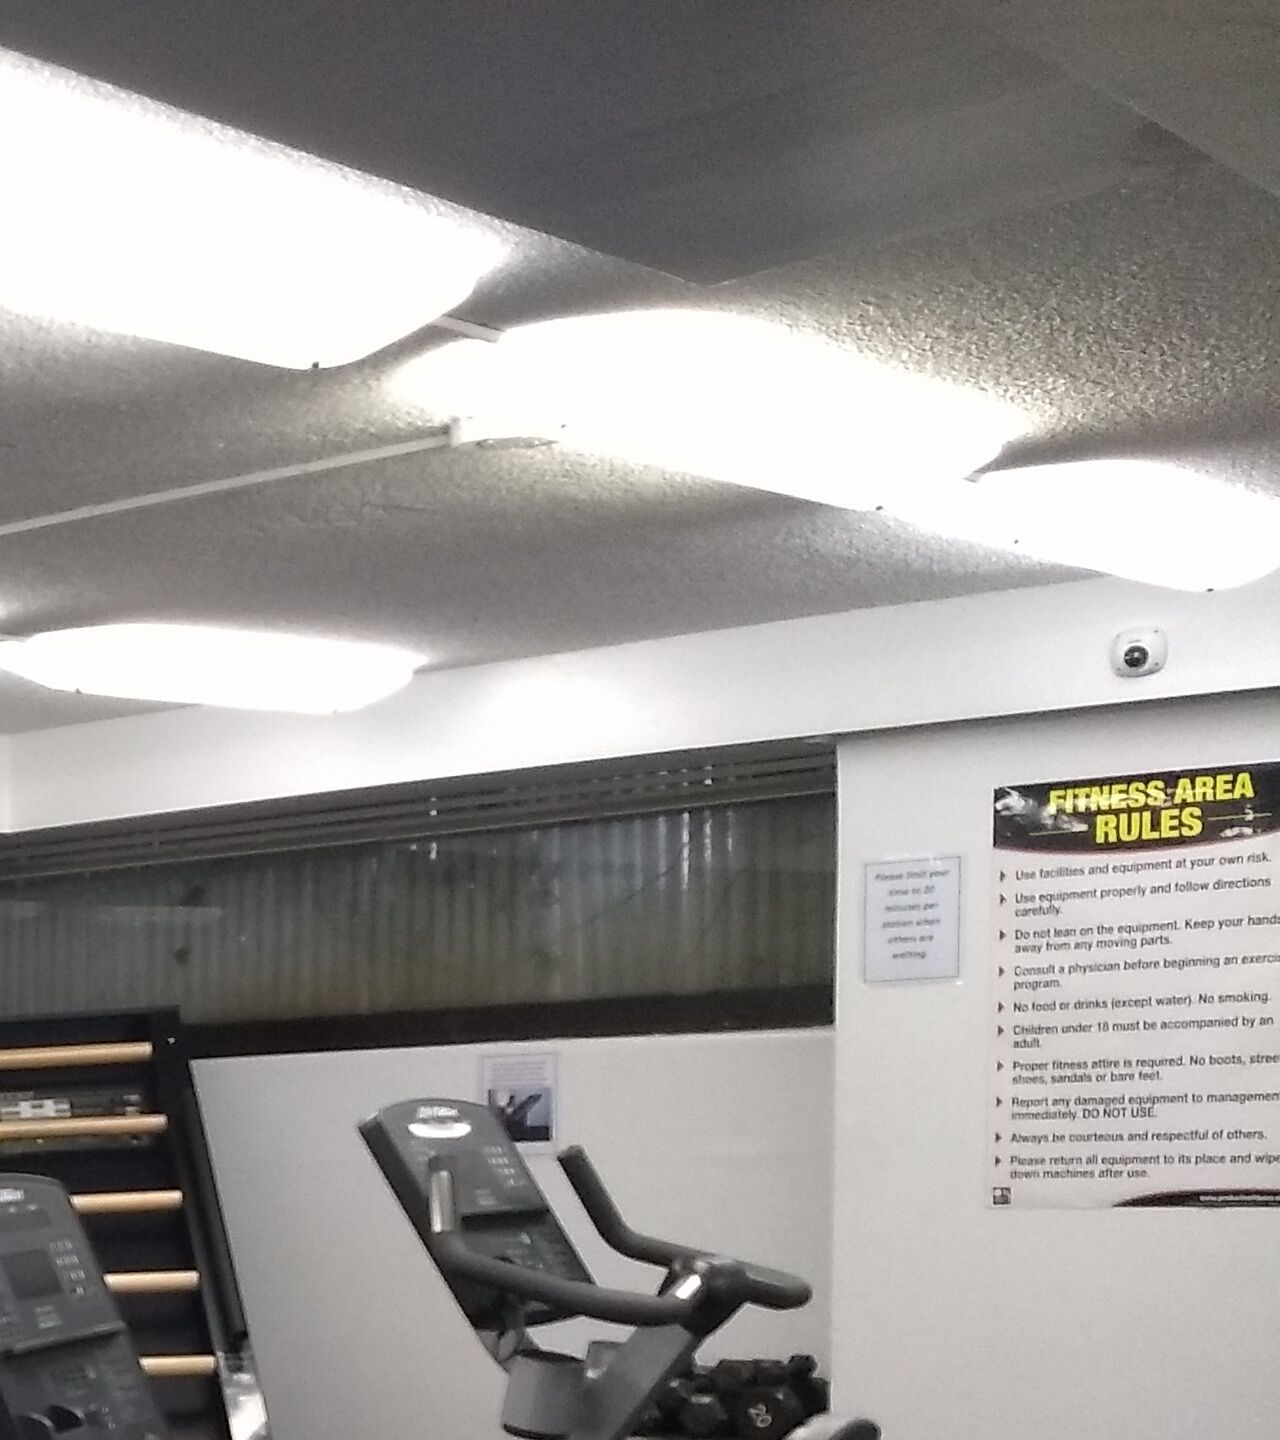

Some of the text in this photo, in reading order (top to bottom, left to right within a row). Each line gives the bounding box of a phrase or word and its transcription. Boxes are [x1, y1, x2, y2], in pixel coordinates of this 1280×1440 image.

[1048, 772, 1255, 815] FITNESS AREA
[1095, 806, 1204, 845] RULES
[1015, 851, 1271, 880] Use facilities and equipment at your own risk.
[1015, 877, 1271, 904] Use equipment properly and follow directions
[1015, 929, 1030, 940] Do
[1033, 928, 1050, 939] not
[1054, 927, 1076, 938] lean
[1079, 927, 1093, 936] on
[1097, 925, 1114, 935] the
[1117, 920, 1180, 935] equipment.
[1184, 919, 1215, 931] Keep
[1218, 918, 1244, 930] your
[1015, 935, 1172, 954] away from any moving parts.
[1014, 964, 1055, 976] Consult
[1058, 966, 1065, 974] a
[1068, 962, 1120, 975] physician
[1124, 960, 1160, 971] before
[1163, 957, 1220, 970] beginning
[1223, 956, 1238, 966] an
[1014, 979, 1062, 991] program.
[1013, 1002, 1029, 1012] No
[1032, 1000, 1057, 1012] food
[1059, 1001, 1070, 1010] or
[1073, 999, 1108, 1010] drinks
[1111, 996, 1152, 1010] (except
[1198, 993, 1214, 1004] No
[1218, 991, 1271, 1004] smoking.
[1013, 1016, 1274, 1035] Children under 18 must be accompanied by an
[1013, 1060, 1049, 1071] Proper
[1052, 1060, 1088, 1070] fitness
[1091, 1059, 1120, 1069] attire
[1123, 1059, 1133, 1068] is
[1136, 1055, 1185, 1069] required.
[1189, 1055, 1205, 1066] No
[1249, 1053, 1280, 1064] stree
[1051, 1073, 1093, 1083] sandals
[1096, 1073, 1107, 1082] or
[1110, 1071, 1135, 1082] bare
[1011, 1097, 1048, 1109] Report
[1052, 1097, 1070, 1108] any
[1074, 1094, 1125, 1107] damaged
[1128, 1093, 1188, 1106] equipment
[1192, 1093, 1203, 1103] to
[1082, 1108, 1100, 1119] DO
[1103, 1107, 1127, 1118] NOT
[1130, 1106, 1157, 1118] USE.
[1011, 1128, 1267, 1144] Always be courteous and respectful of others.
[1010, 1155, 1046, 1166] Please
[1049, 1156, 1082, 1165] return
[1085, 1154, 1098, 1164] all
[1101, 1155, 1160, 1167] equipment
[1163, 1154, 1175, 1164] to
[1178, 1154, 1192, 1164] its
[1194, 1153, 1226, 1166] place
[1229, 1152, 1252, 1163] and
[1010, 1170, 1039, 1179] down
[1043, 1169, 1095, 1179] machines
[1098, 1168, 1124, 1178] after
